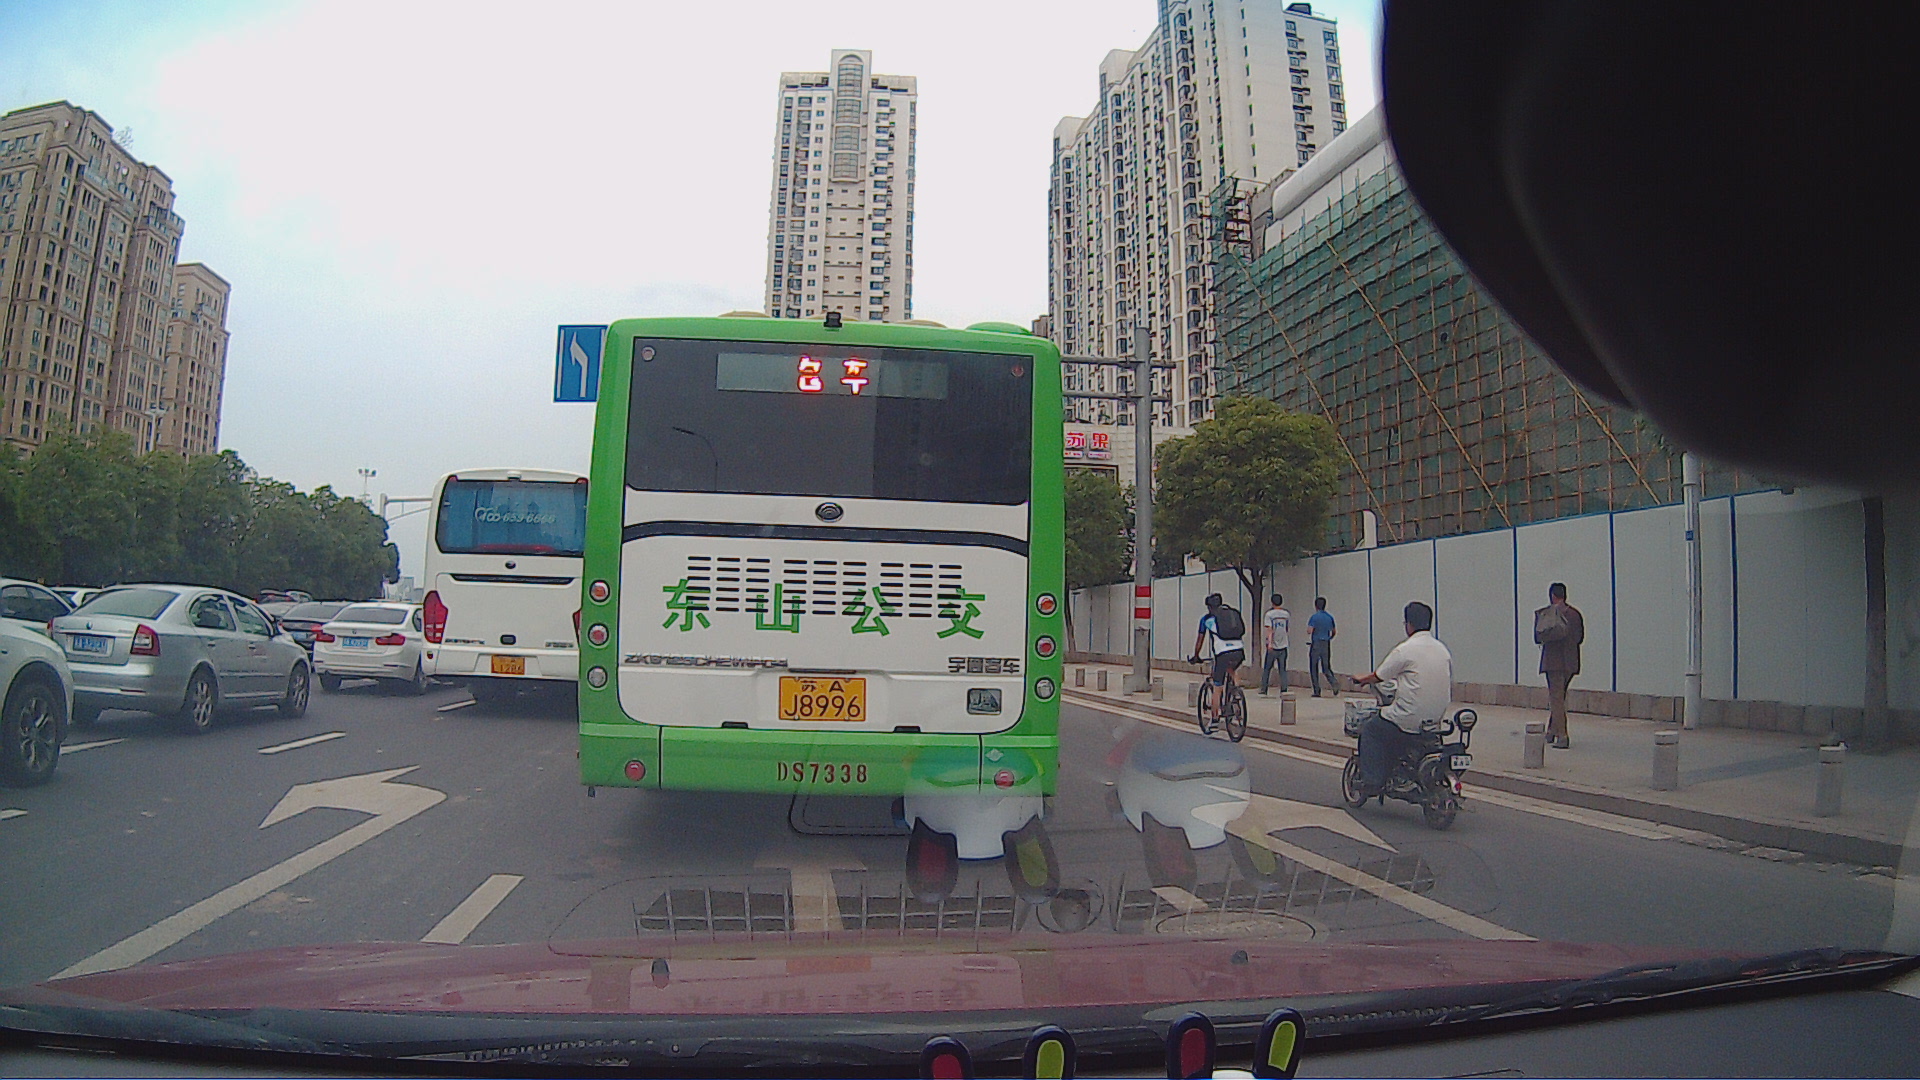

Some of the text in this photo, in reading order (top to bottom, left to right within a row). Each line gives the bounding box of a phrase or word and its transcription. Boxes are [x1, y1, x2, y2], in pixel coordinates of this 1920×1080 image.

[1065, 431, 1109, 449] 苏果
[662, 578, 986, 639] 东山公交
[783, 694, 861, 718] J8996
[777, 761, 868, 784] DS7338
